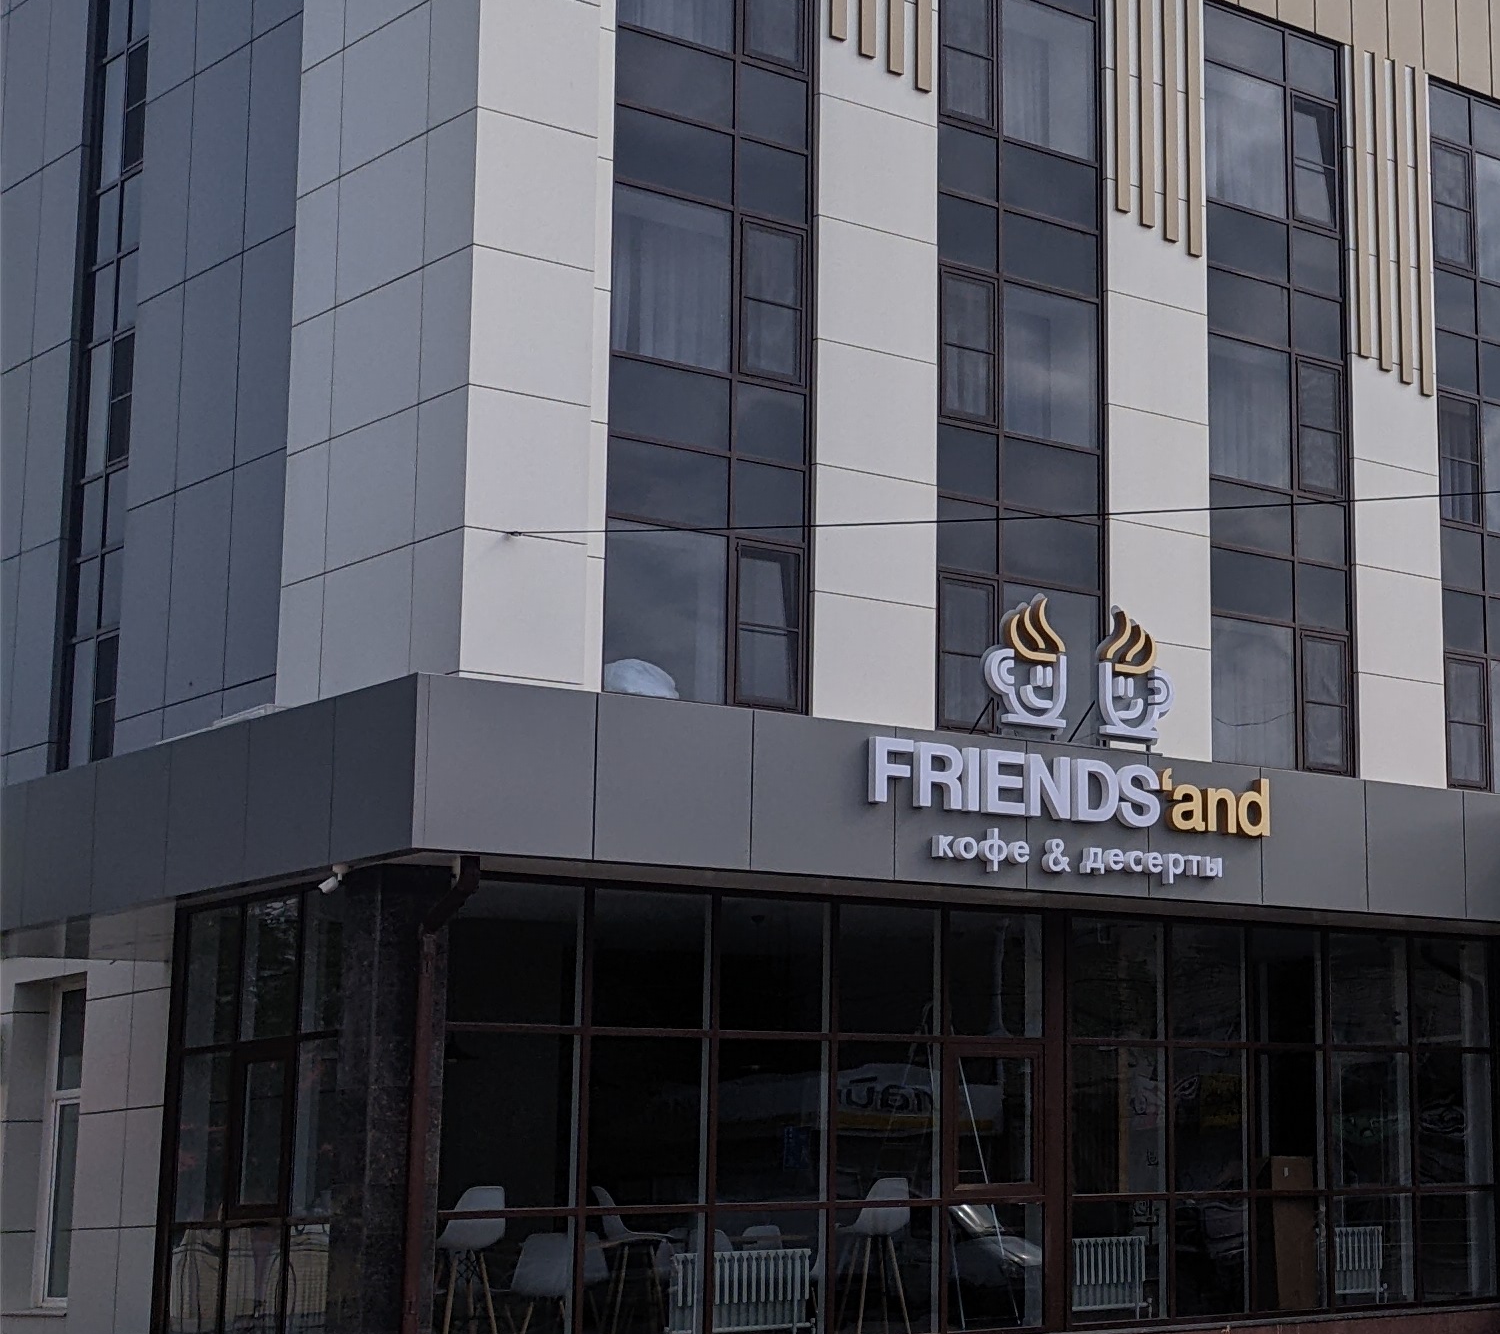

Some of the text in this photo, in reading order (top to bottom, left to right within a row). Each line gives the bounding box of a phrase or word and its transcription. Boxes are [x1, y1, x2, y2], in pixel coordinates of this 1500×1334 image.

[932, 828, 1223, 885] кофе & десерты
